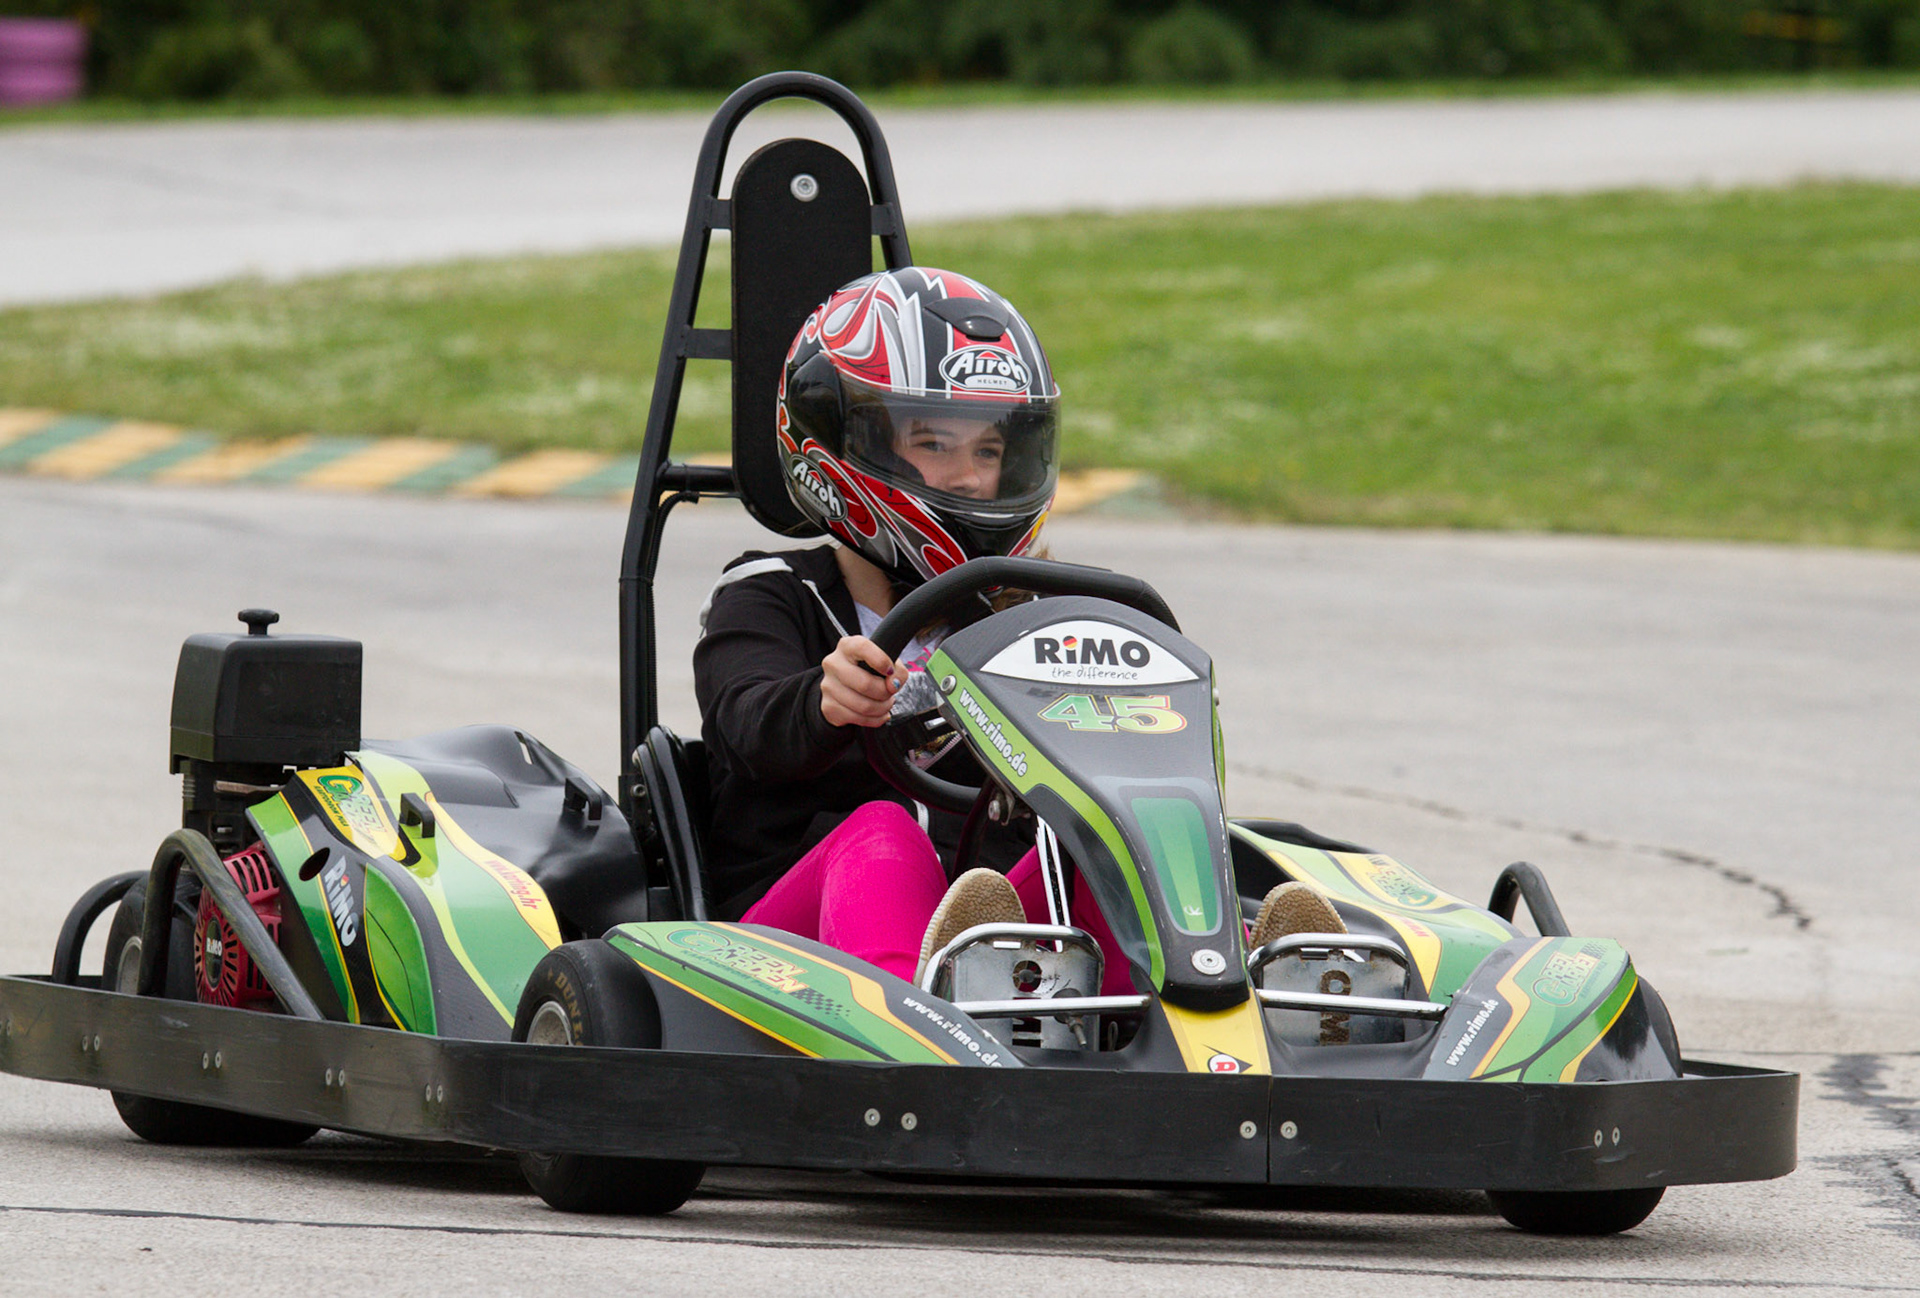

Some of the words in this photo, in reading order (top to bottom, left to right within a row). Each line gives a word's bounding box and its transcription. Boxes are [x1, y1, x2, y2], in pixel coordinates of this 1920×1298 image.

[949, 352, 1027, 384] Airoh
[793, 461, 841, 517] Airoh
[1052, 666, 1072, 678] the
[1076, 666, 1138, 680] difference
[958, 688, 1028, 777] www.rimo.de
[1037, 693, 1188, 735] 45
[1445, 998, 1499, 1067] www.rimo.de
